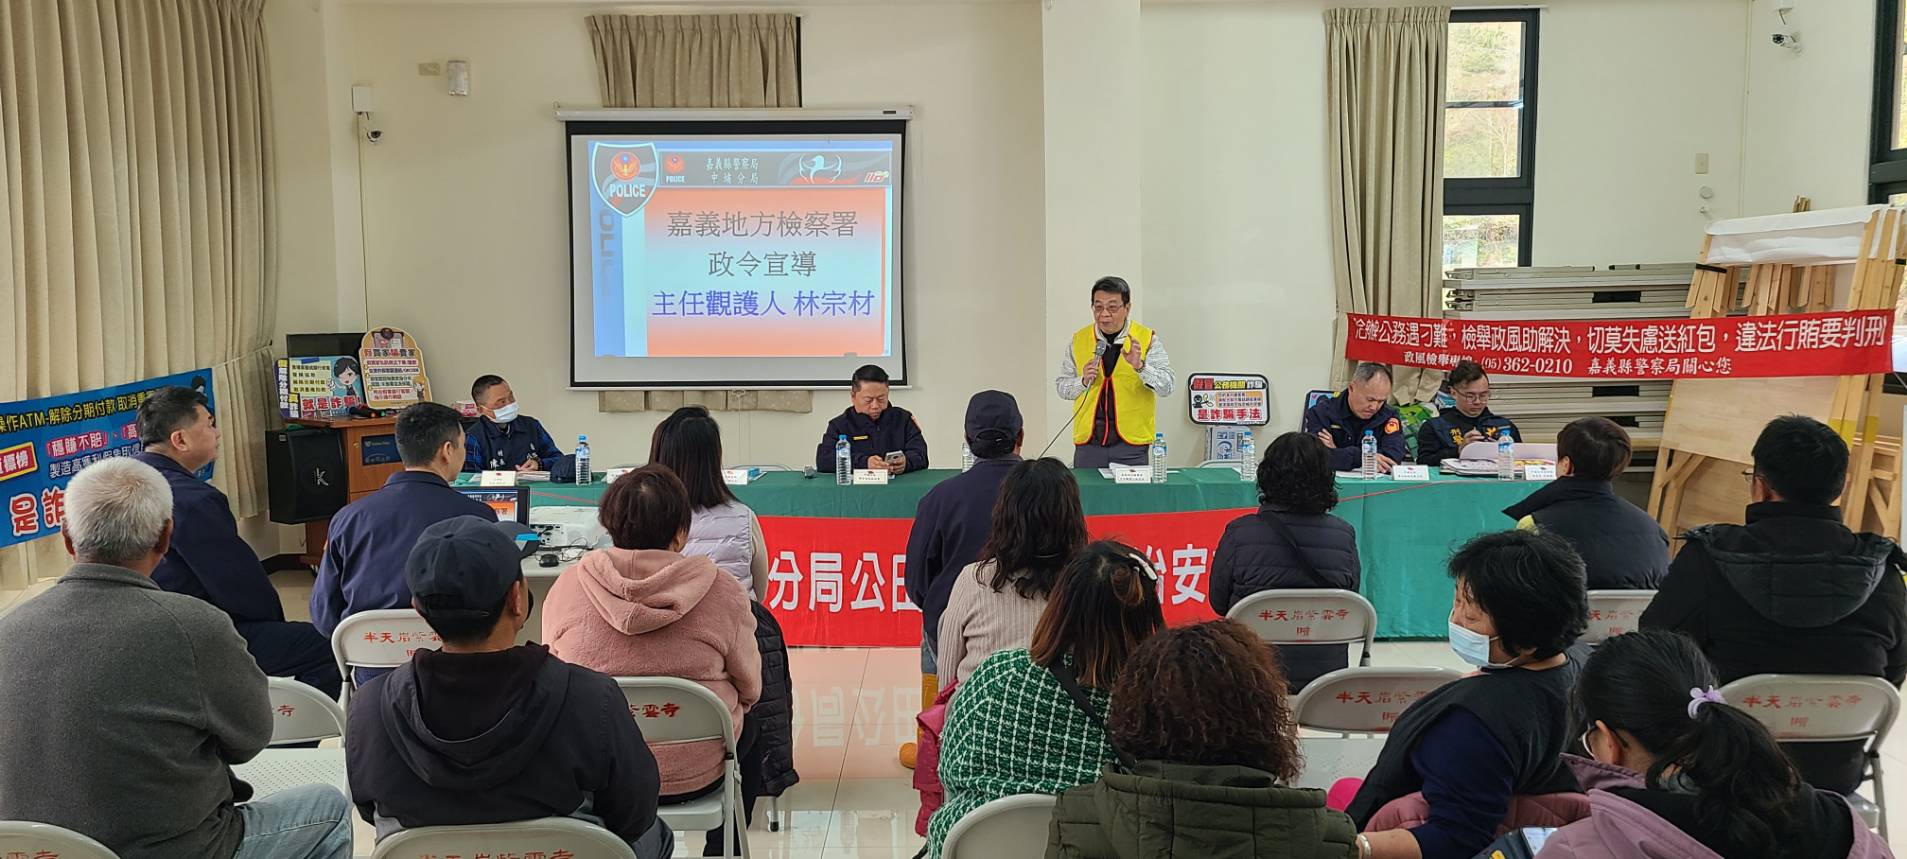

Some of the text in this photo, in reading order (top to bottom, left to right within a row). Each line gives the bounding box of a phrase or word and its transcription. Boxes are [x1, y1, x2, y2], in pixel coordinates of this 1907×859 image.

[609, 184, 646, 198] POLICE
[667, 211, 858, 237] 嘉義地方檢察署
[708, 251, 817, 277] 政令宣導
[652, 290, 875, 317] 主任觀護人 林宗材
[1588, 357, 1732, 376] 嘉義縣警察局關心您
[1198, 408, 1262, 420] 是詐騙手法
